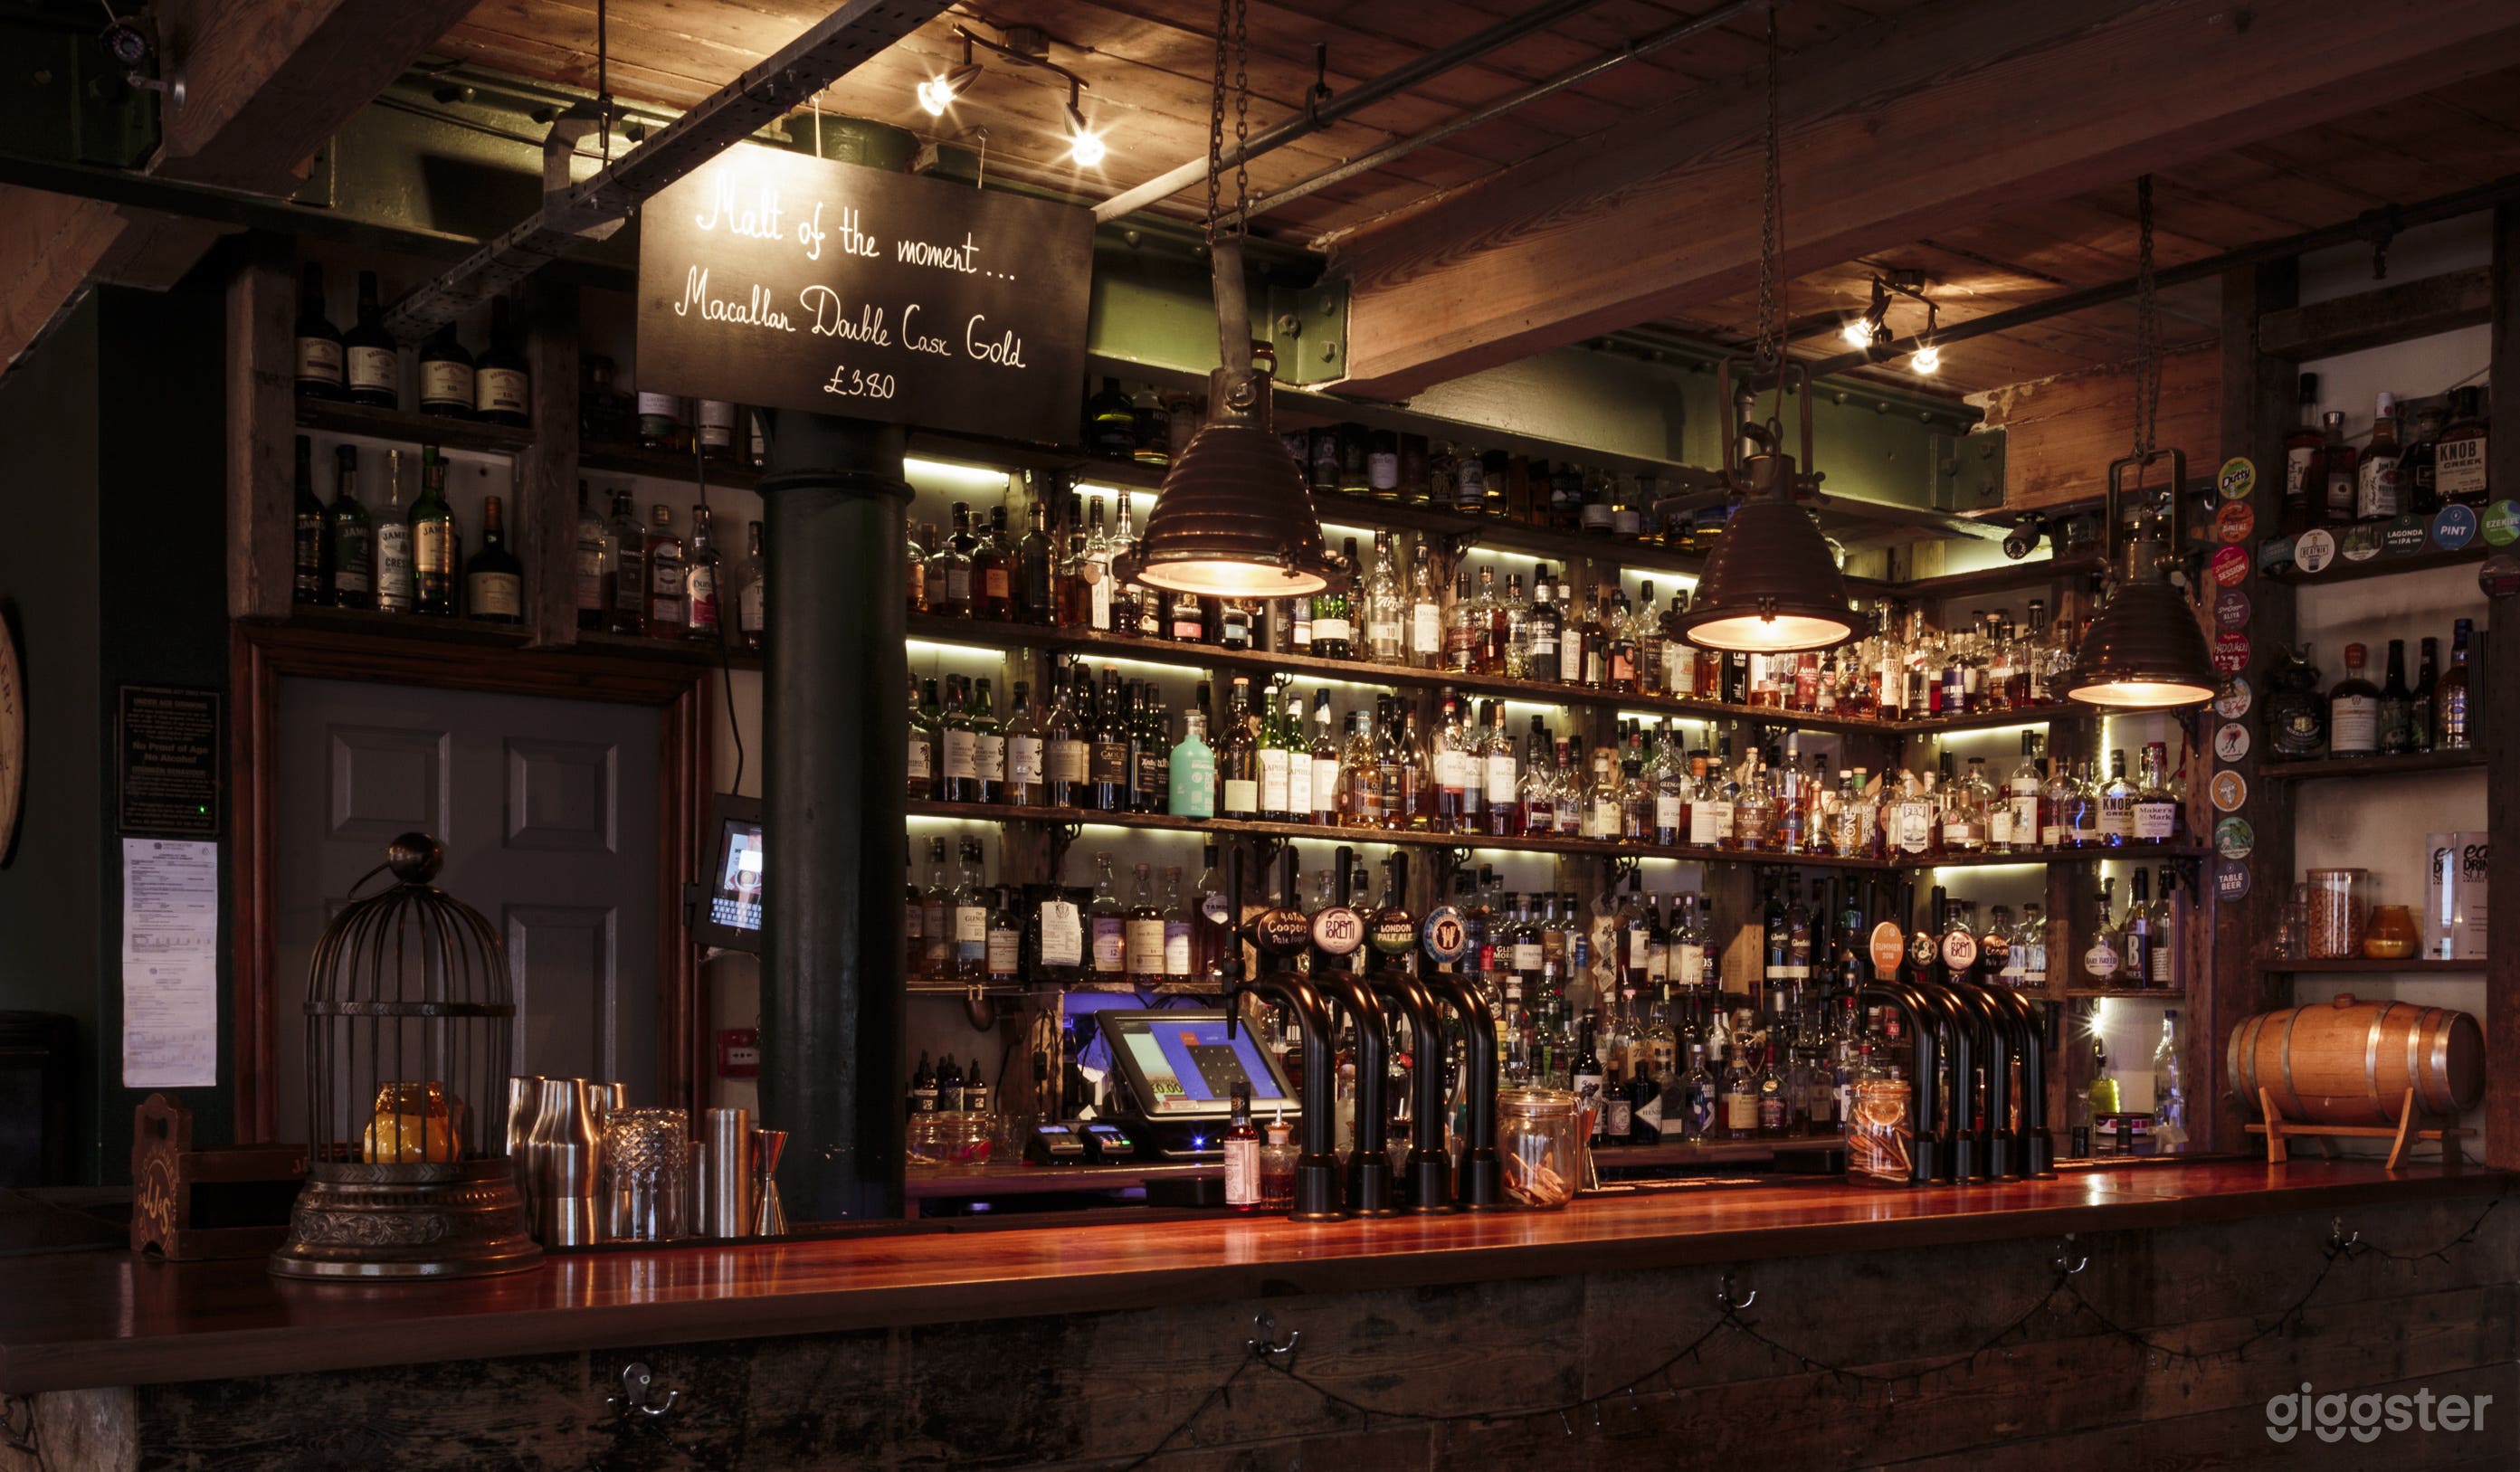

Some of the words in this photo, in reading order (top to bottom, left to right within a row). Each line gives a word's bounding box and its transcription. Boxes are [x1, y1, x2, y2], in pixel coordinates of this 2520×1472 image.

[799, 202, 825, 260] of
[839, 206, 880, 257] the
[675, 265, 795, 332] Macallan
[800, 285, 891, 347] Double
[902, 304, 952, 356] Cask
[966, 314, 1026, 368] Gold
[823, 365, 895, 399] £3.80
[2439, 441, 2477, 461] KNOB
[2444, 458, 2482, 469] CREEK
[2221, 469, 2251, 489] Dutty
[2387, 529, 2423, 538] LAGONDA
[2440, 526, 2467, 536] PINT
[132, 741, 146, 750] No
[148, 742, 175, 752] Proof
[176, 745, 186, 753] of
[188, 745, 209, 755] Age
[145, 753, 157, 761] No
[160, 754, 197, 764] Alcohol
[2103, 798, 2132, 810] KNOB
[2219, 873, 2243, 883] TABLE
[2220, 881, 2241, 890] BEER
[1381, 923, 1412, 933] LONDON
[1377, 933, 1396, 942] PALE
[1397, 933, 1413, 942] ALE
[1875, 942, 1901, 951] SUMMER
